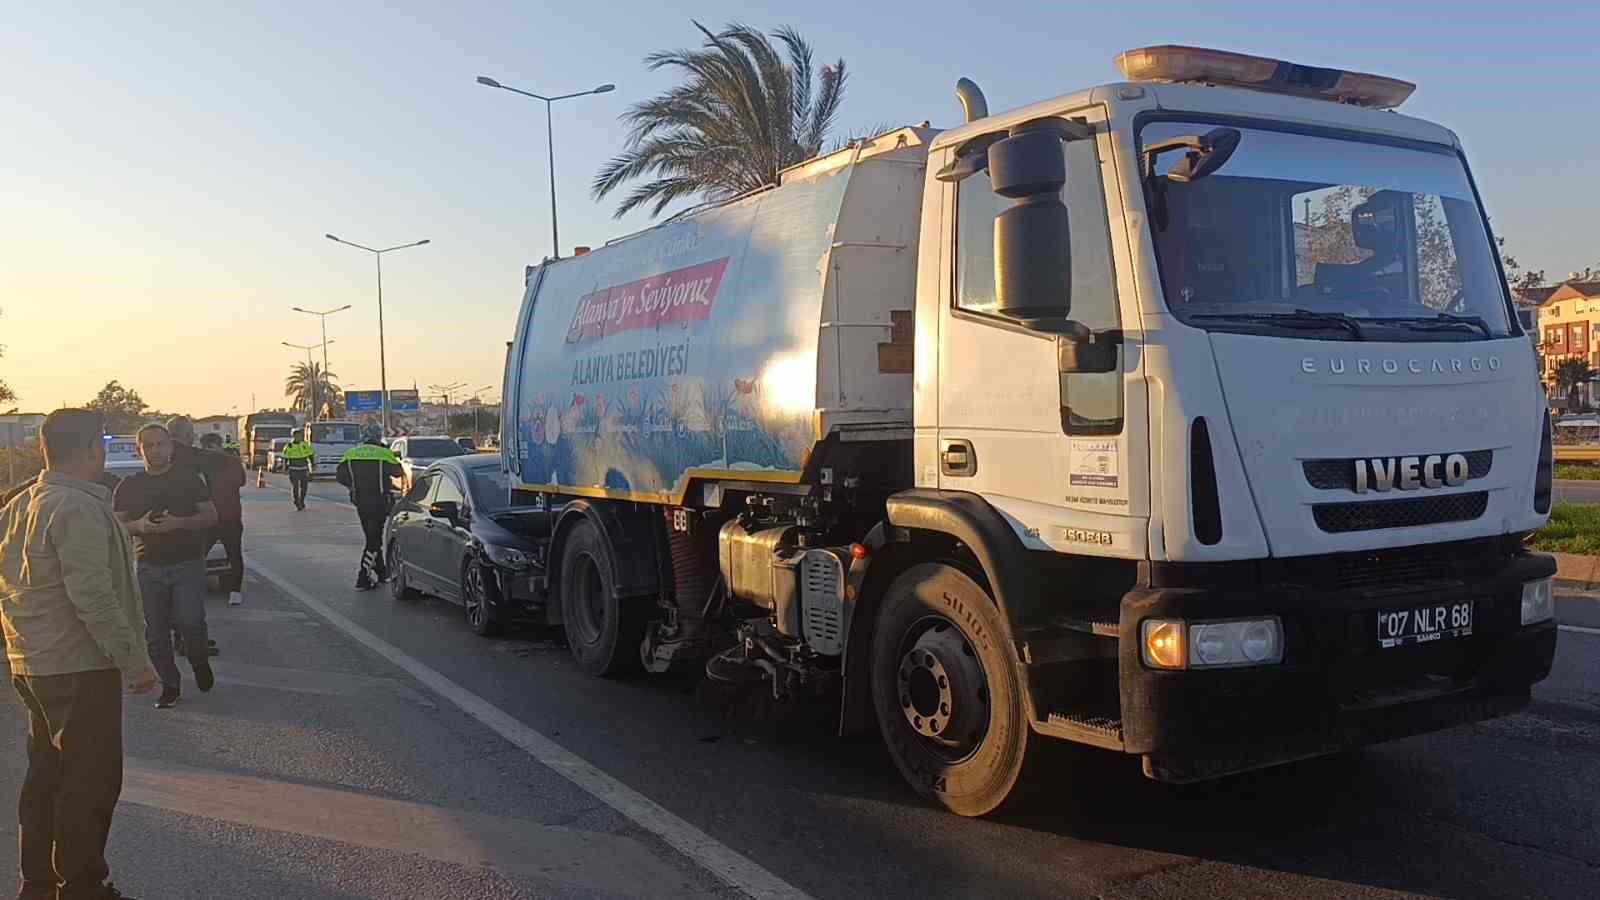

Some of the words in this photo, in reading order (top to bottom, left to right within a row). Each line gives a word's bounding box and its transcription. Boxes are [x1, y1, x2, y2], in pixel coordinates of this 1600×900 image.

[636, 277, 712, 316] Seviyoruz
[571, 355, 614, 385] ALANYA
[616, 337, 690, 381] BELEDİYESİ
[1301, 356, 1502, 374] EUROCARGO
[1353, 453, 1470, 494] IVECO
[1387, 611, 1409, 636] 07
[1414, 606, 1446, 633] NLR
[1451, 603, 1469, 627] 68
